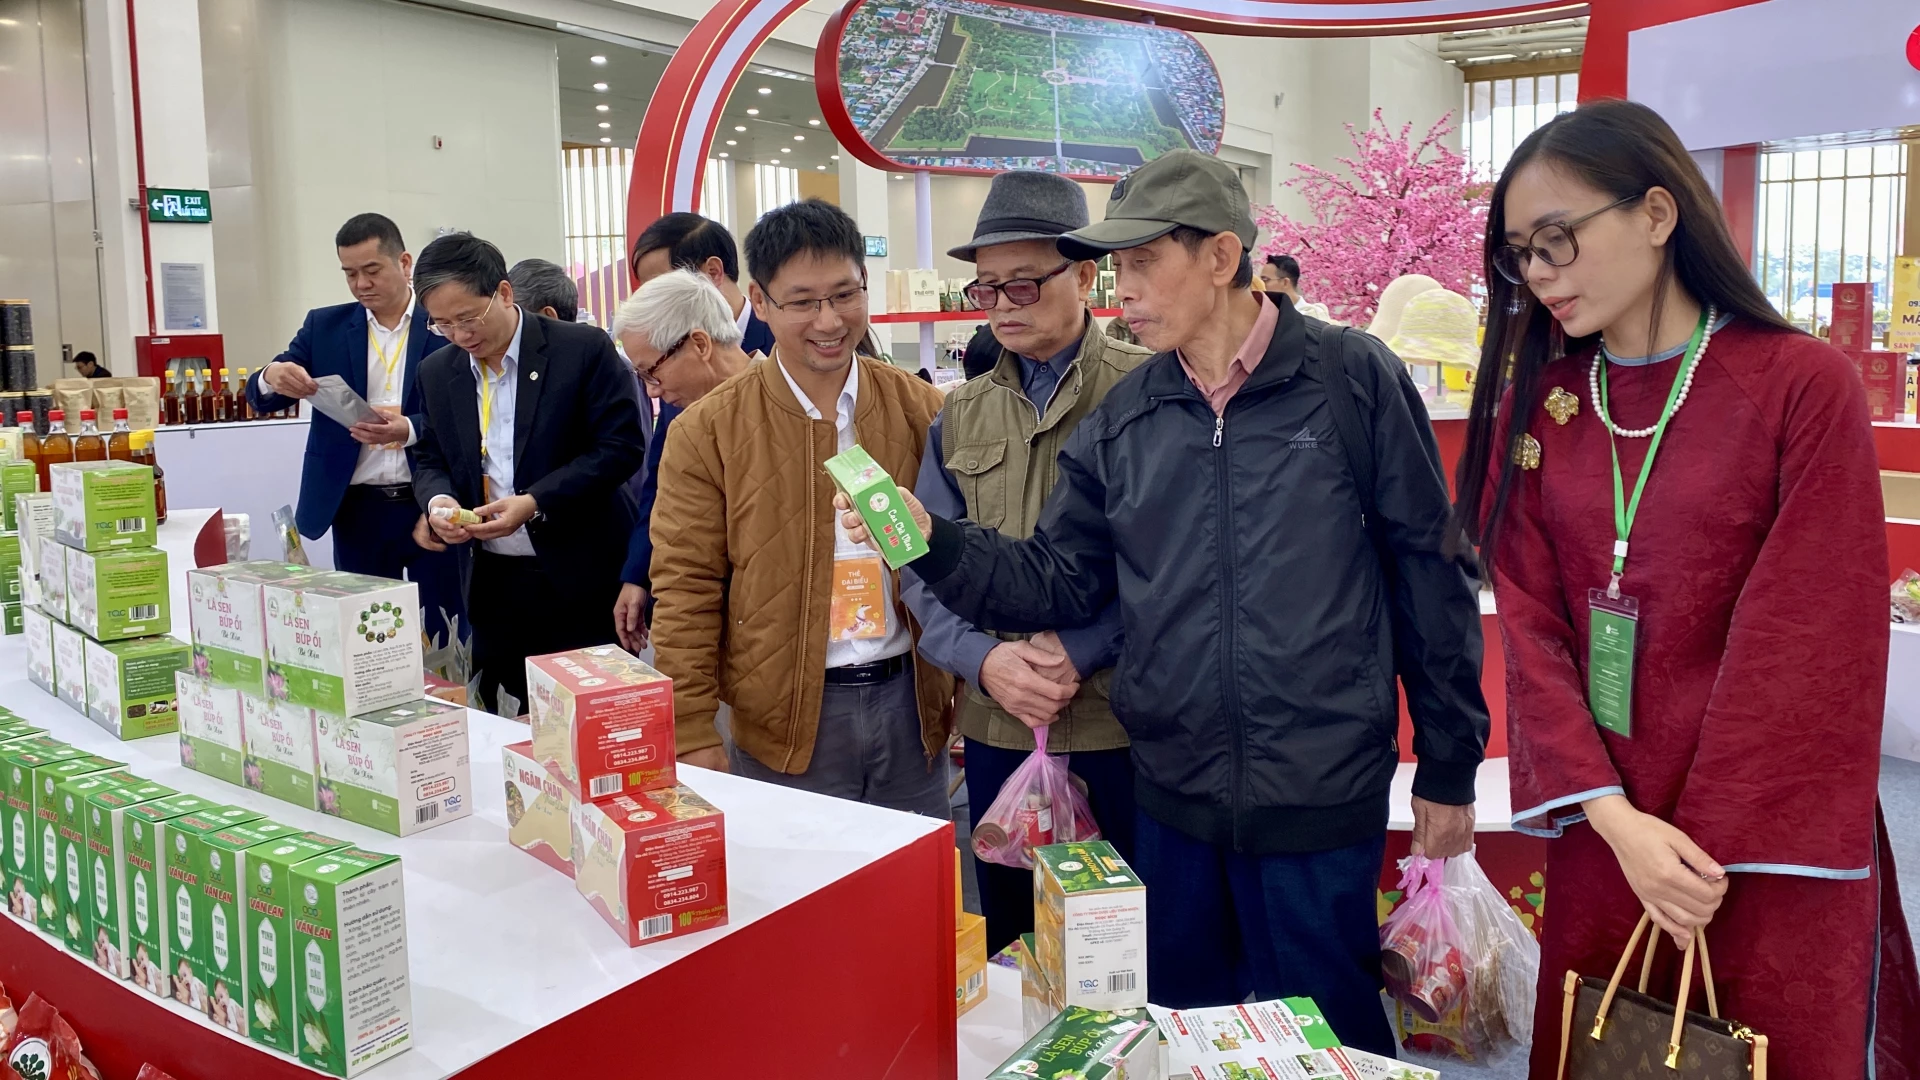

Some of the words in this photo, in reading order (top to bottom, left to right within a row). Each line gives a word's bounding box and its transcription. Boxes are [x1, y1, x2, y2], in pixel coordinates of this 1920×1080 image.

[184, 196, 201, 205] EXIT
[1288, 441, 1318, 449] WUKE
[218, 601, 231, 614] SEN
[284, 613, 293, 627] LÁ
[295, 617, 309, 630] SEN
[296, 631, 311, 645] BÚP
[271, 720, 282, 731] SEN
[347, 741, 360, 752] SEN
[519, 768, 542, 791] NGÂM
[444, 795, 461, 807] TQC
[50, 811, 58, 822] LA
[182, 871, 198, 885] LAN
[217, 889, 232, 904] LAN
[663, 886, 699, 898] 0914.223.987
[663, 894, 699, 906] 0834.234.804
[267, 903, 284, 918] LAN
[313, 925, 332, 941] LAN
[1079, 979, 1098, 988] TQC
[1039, 1051, 1060, 1062] LÁ
[1053, 1035, 1077, 1051] SEN
[1068, 1038, 1092, 1055] BÚP
